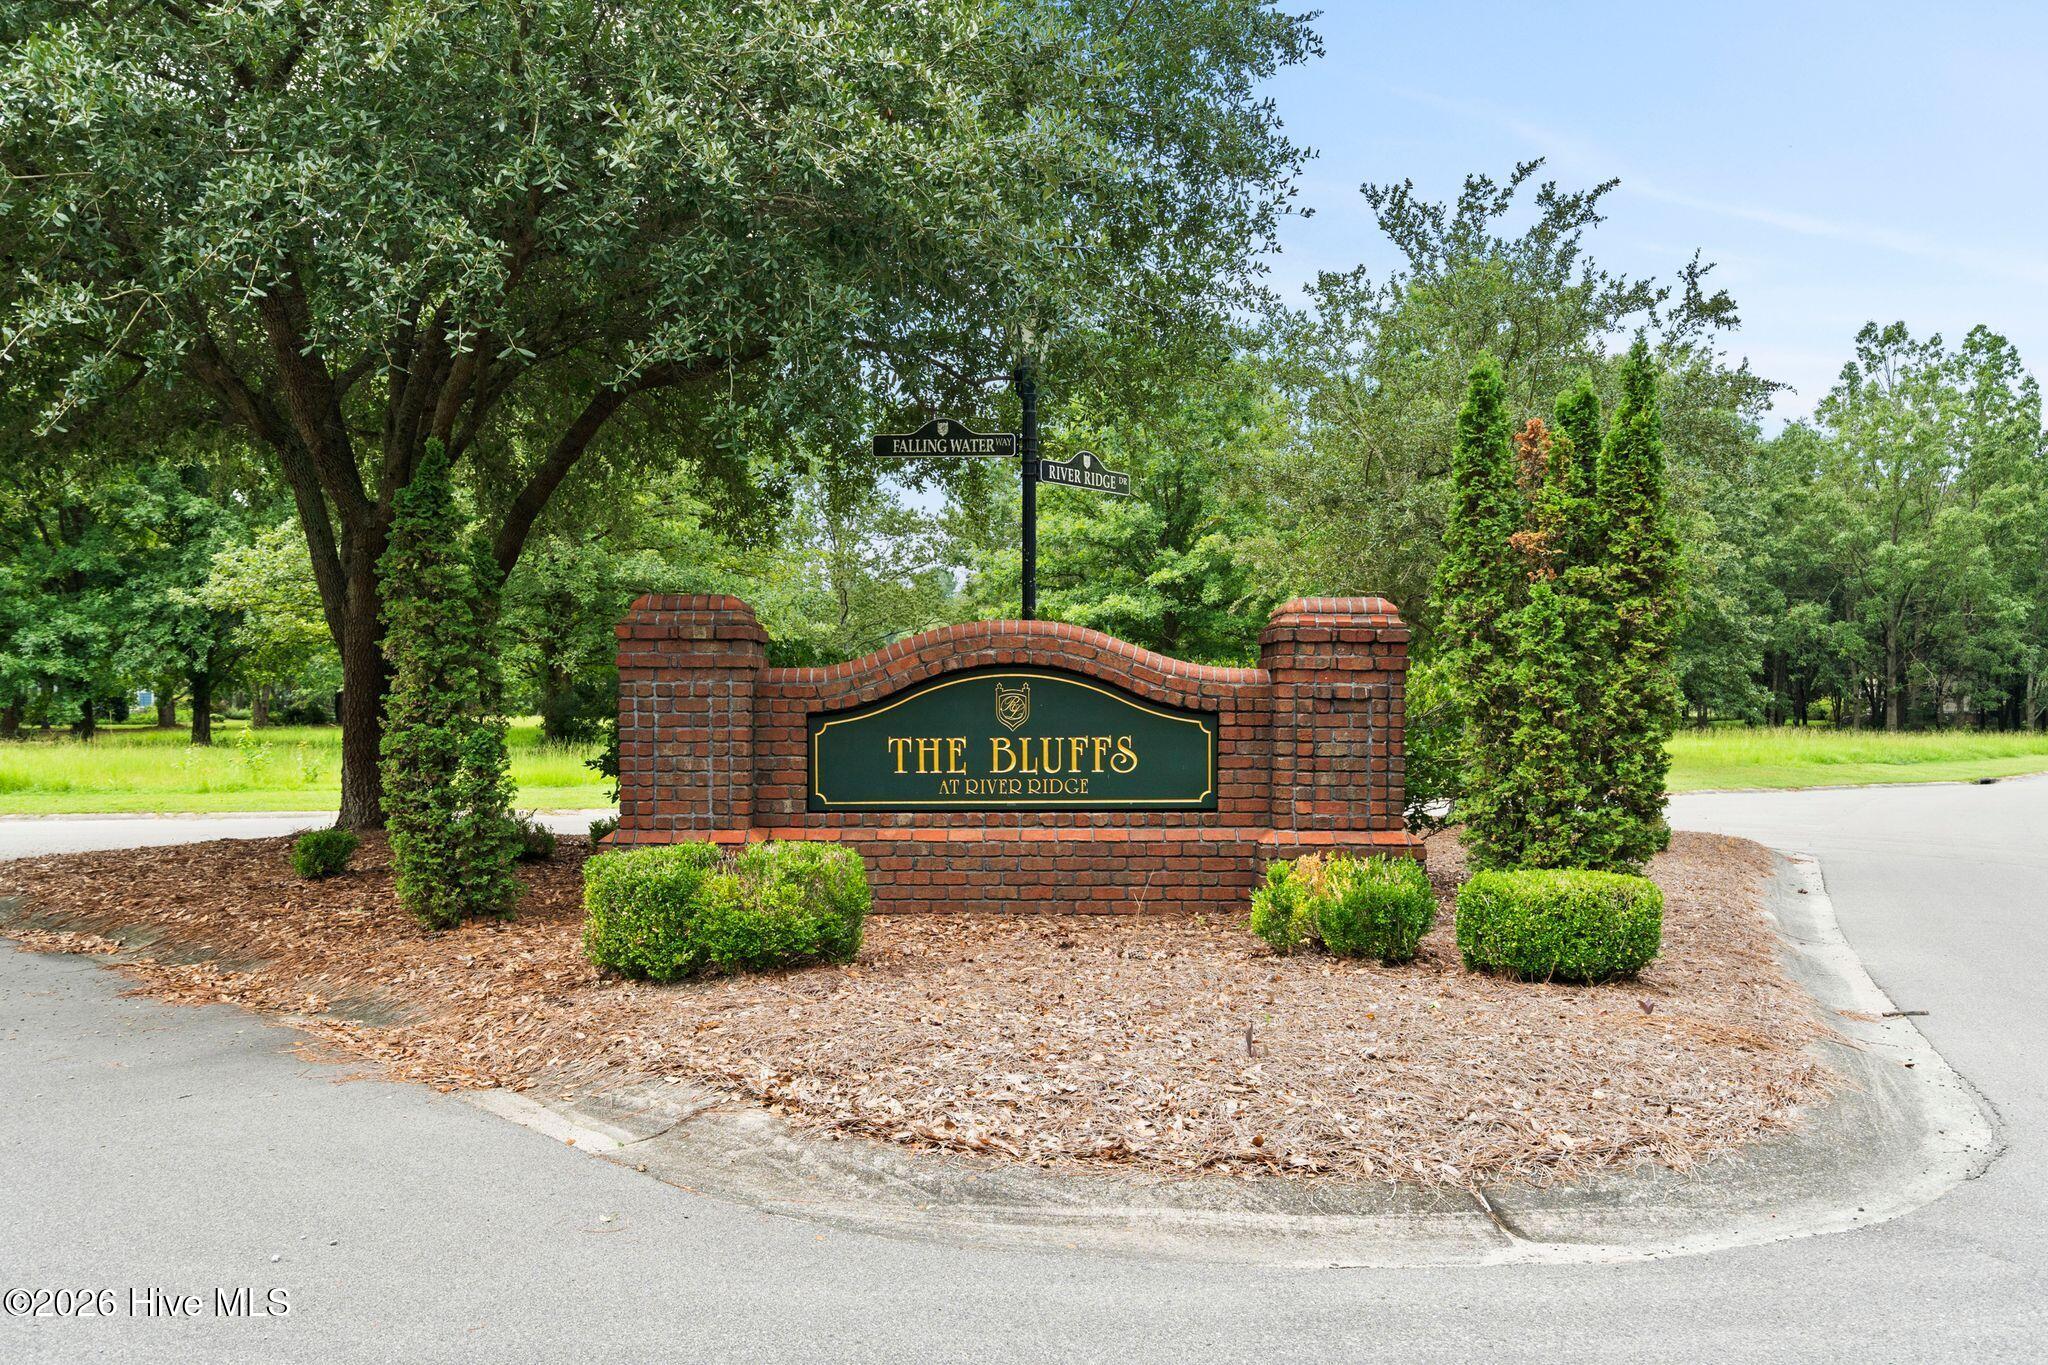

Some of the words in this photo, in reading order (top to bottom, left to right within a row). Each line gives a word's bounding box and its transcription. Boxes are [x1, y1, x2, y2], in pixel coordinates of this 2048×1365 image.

[892, 438, 948, 453] FALLING
[949, 438, 995, 453] WATER
[996, 437, 1012, 447] WAY
[1049, 464, 1081, 484] RIVER
[1084, 471, 1116, 490] RIDGE
[1118, 476, 1128, 486] DR
[888, 736, 967, 775] THE
[989, 736, 1138, 775] BLUFFS
[938, 780, 960, 795] AT
[965, 779, 1022, 795] RIVER
[1027, 779, 1089, 795] RIDGE
